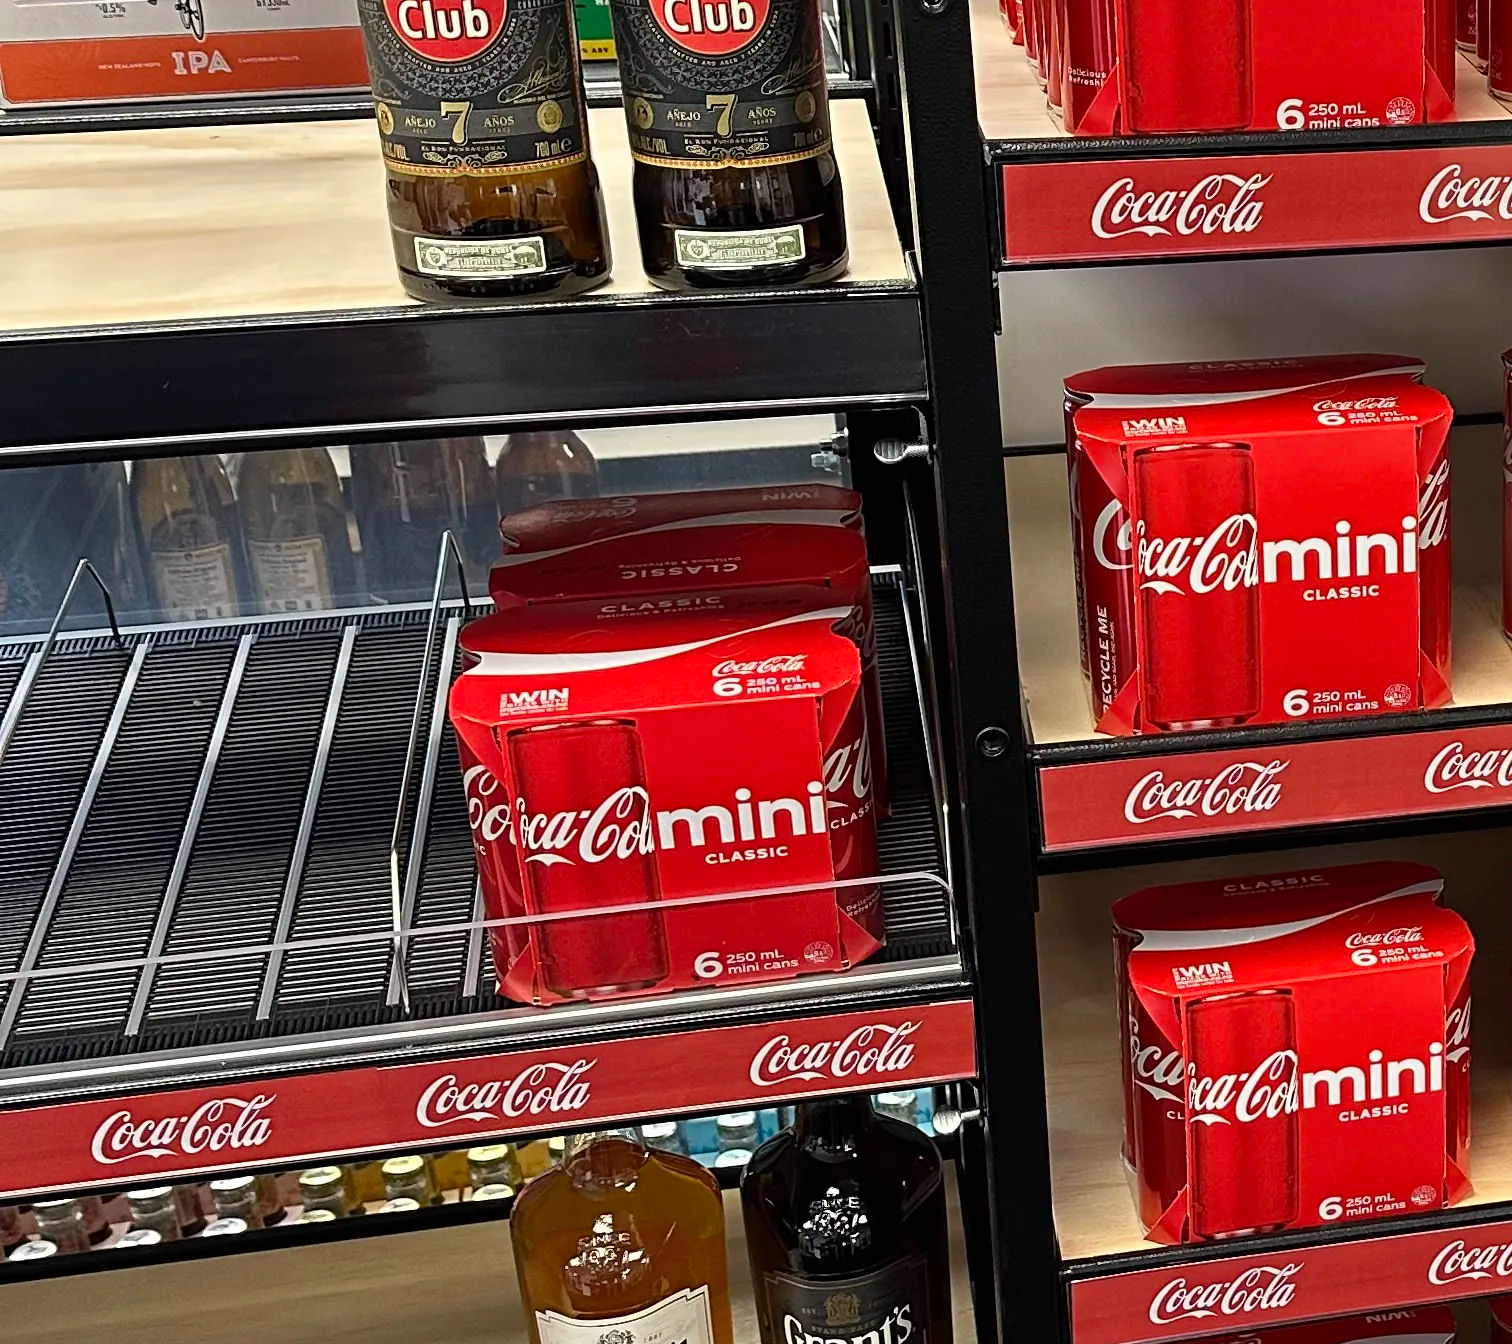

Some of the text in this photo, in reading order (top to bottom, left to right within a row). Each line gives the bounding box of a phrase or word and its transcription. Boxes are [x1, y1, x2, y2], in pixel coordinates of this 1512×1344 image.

[398, 0, 489, 39] Club
[172, 50, 232, 75] IPA
[405, 102, 515, 144] AÑEJO 7 AÑOS
[667, 94, 776, 136] AÑEJO 7 AÑOS
[1276, 98, 1367, 129] 6 250 mL
[1092, 174, 1272, 238] Coca-Cola
[1260, 516, 1418, 583] mini
[1303, 585, 1379, 601] CLASSIC
[1283, 689, 1366, 716] 6 250 mL
[1313, 701, 1379, 713] mini cans
[1125, 761, 1288, 823] Coca-Cola
[657, 780, 825, 849] mini
[705, 847, 788, 865] CLASSIC
[695, 949, 784, 978] 6 250 mL
[728, 957, 799, 973] mini cans
[751, 1020, 921, 1085] Coca-Cola
[417, 1060, 596, 1127] Coca-Cola
[1303, 1042, 1443, 1109] mini
[92, 1095, 276, 1163] Coca-Cola
[1339, 1103, 1409, 1122] CLASSIC
[1150, 1263, 1304, 1323] Coca-Cola
